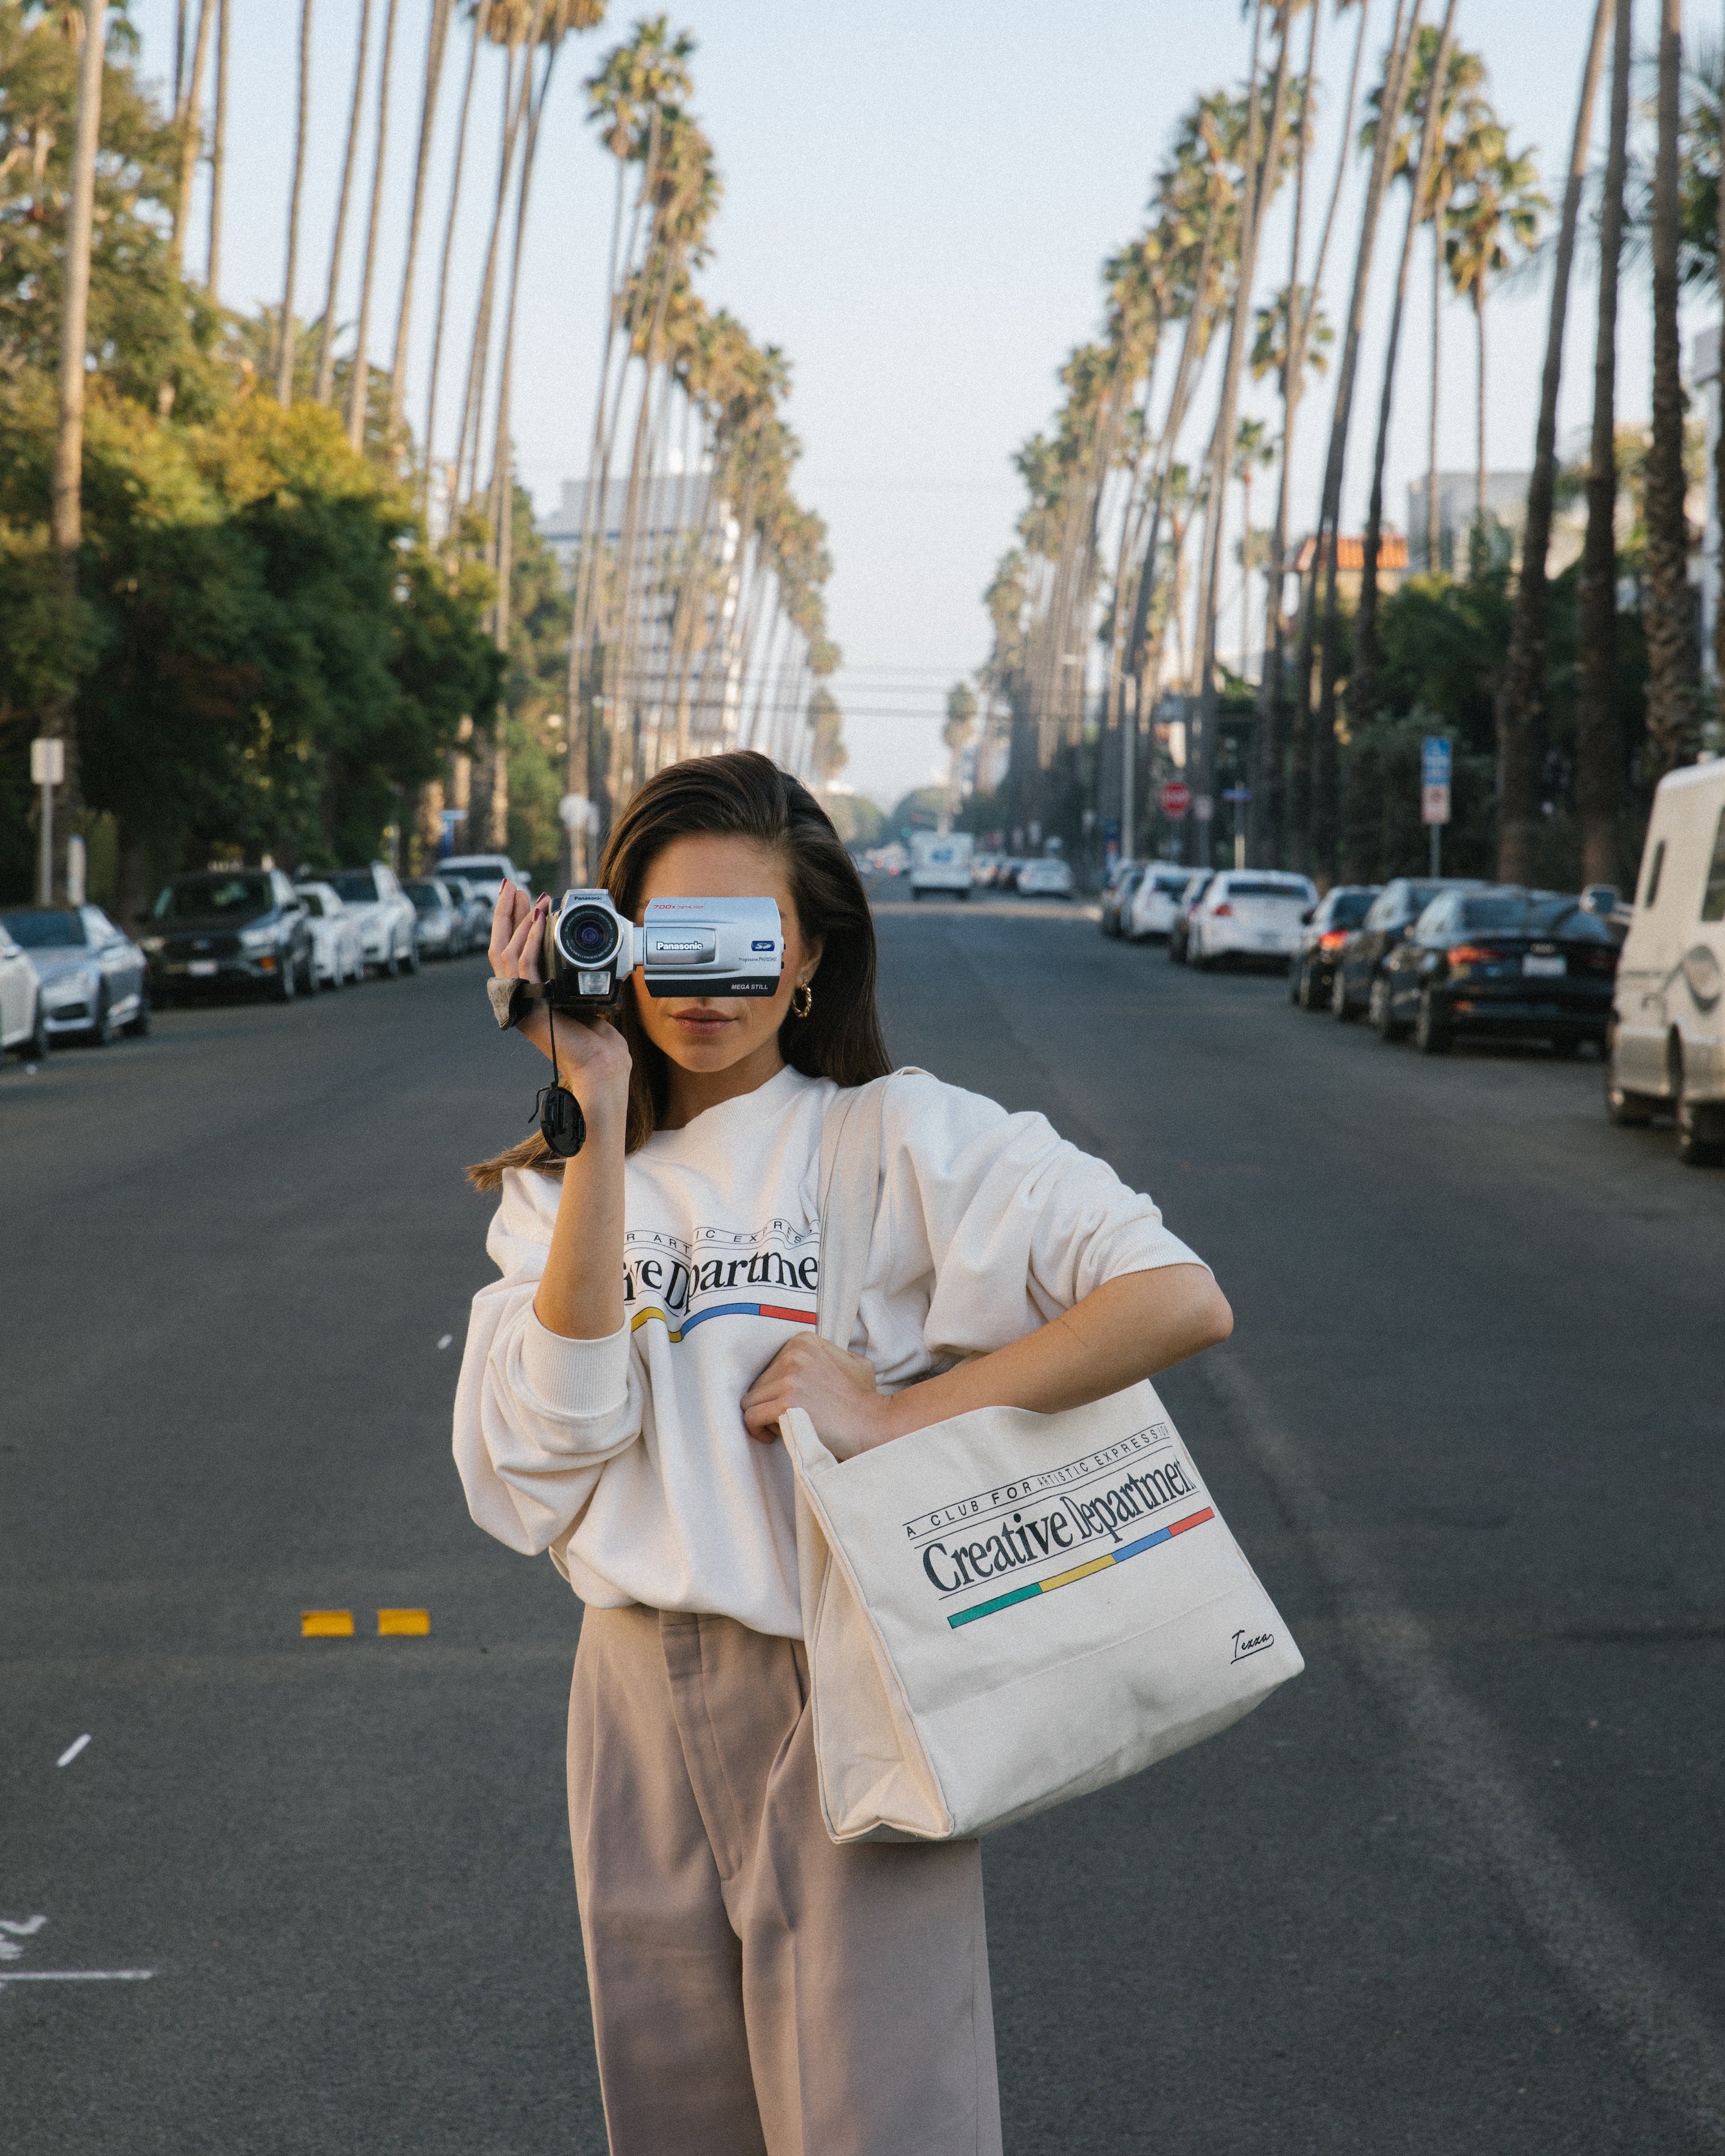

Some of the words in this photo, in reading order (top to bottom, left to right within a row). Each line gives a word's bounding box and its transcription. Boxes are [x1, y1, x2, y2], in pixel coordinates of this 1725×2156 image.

[657, 941, 703, 950] Panasonic
[905, 1525, 916, 1537] A
[931, 1500, 979, 1527] CLUB
[993, 1482, 1032, 1504] FOR
[1036, 1462, 1088, 1487] ARTISTIC
[922, 1512, 1074, 1593] Creative
[1231, 1629, 1274, 1664] Tezza
